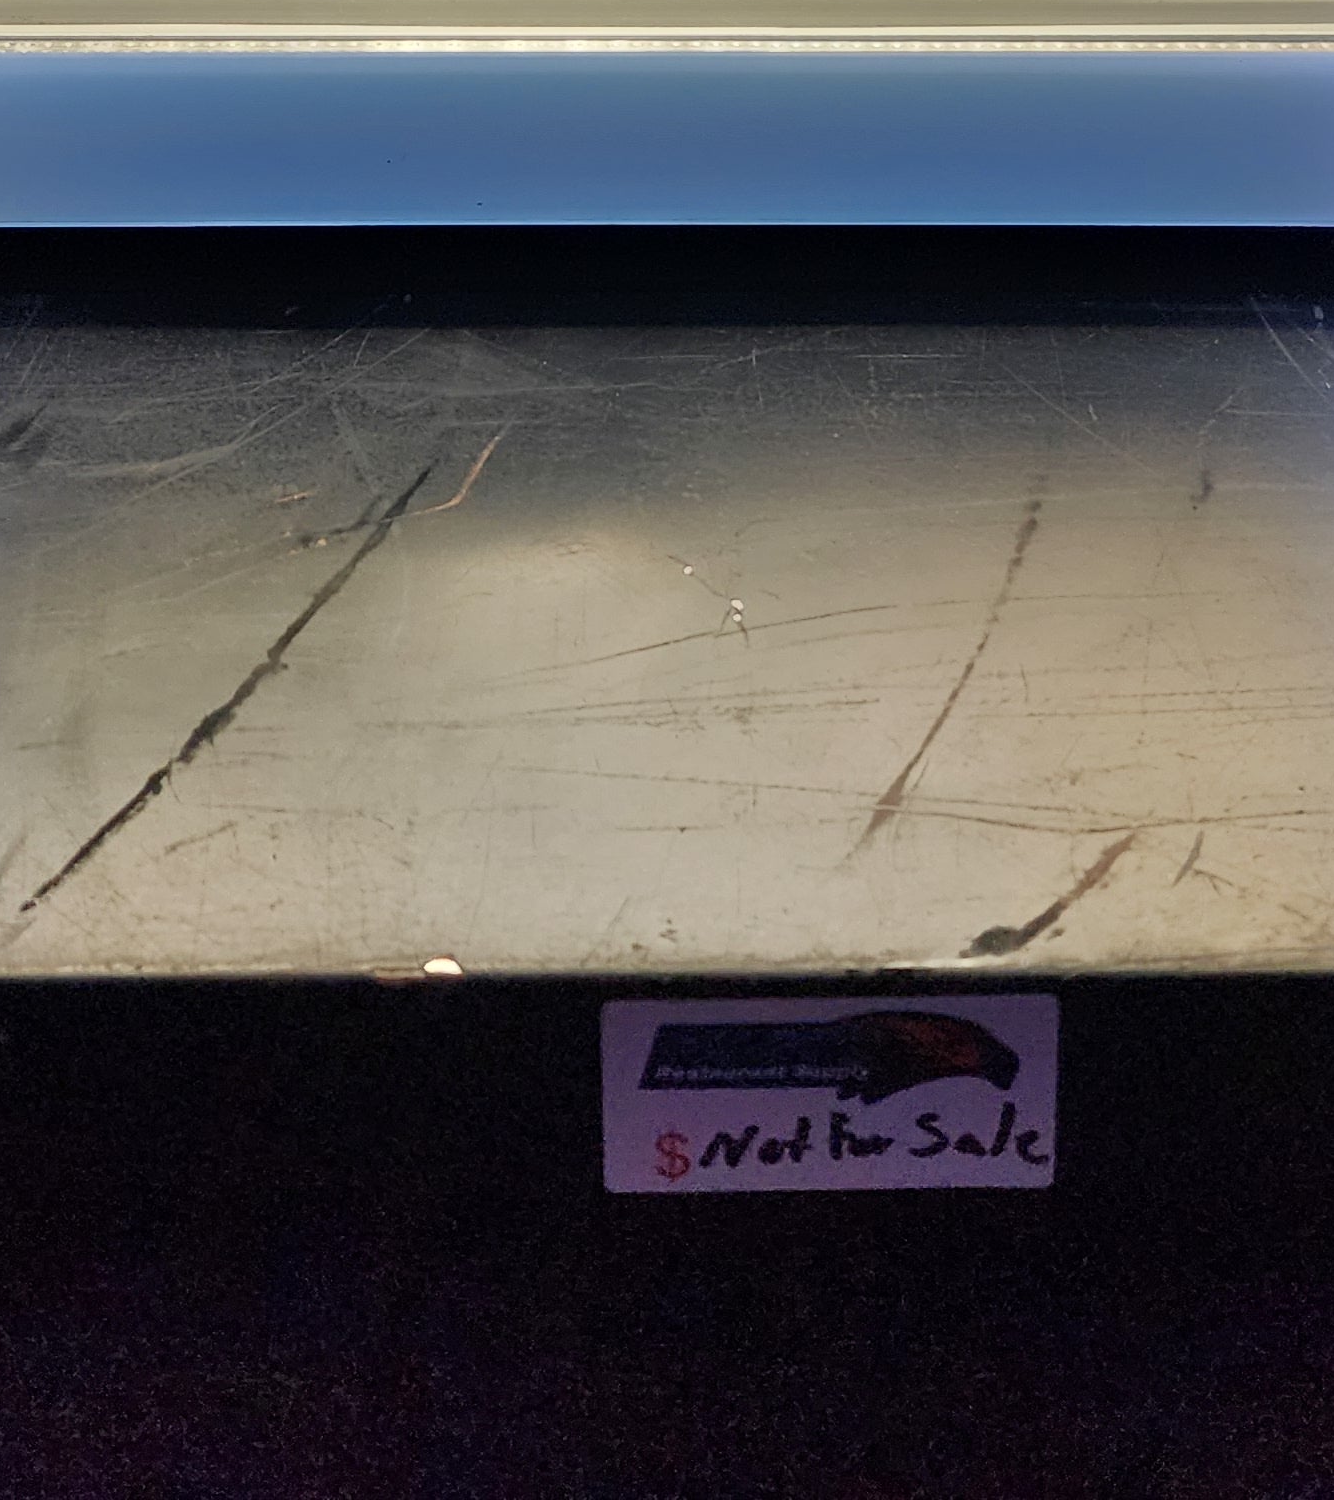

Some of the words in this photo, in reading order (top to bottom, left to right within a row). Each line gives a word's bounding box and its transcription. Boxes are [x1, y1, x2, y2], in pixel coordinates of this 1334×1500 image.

[655, 1130, 691, 1182] $
[699, 1114, 812, 1169] Not
[909, 1101, 1049, 1165] Sale
